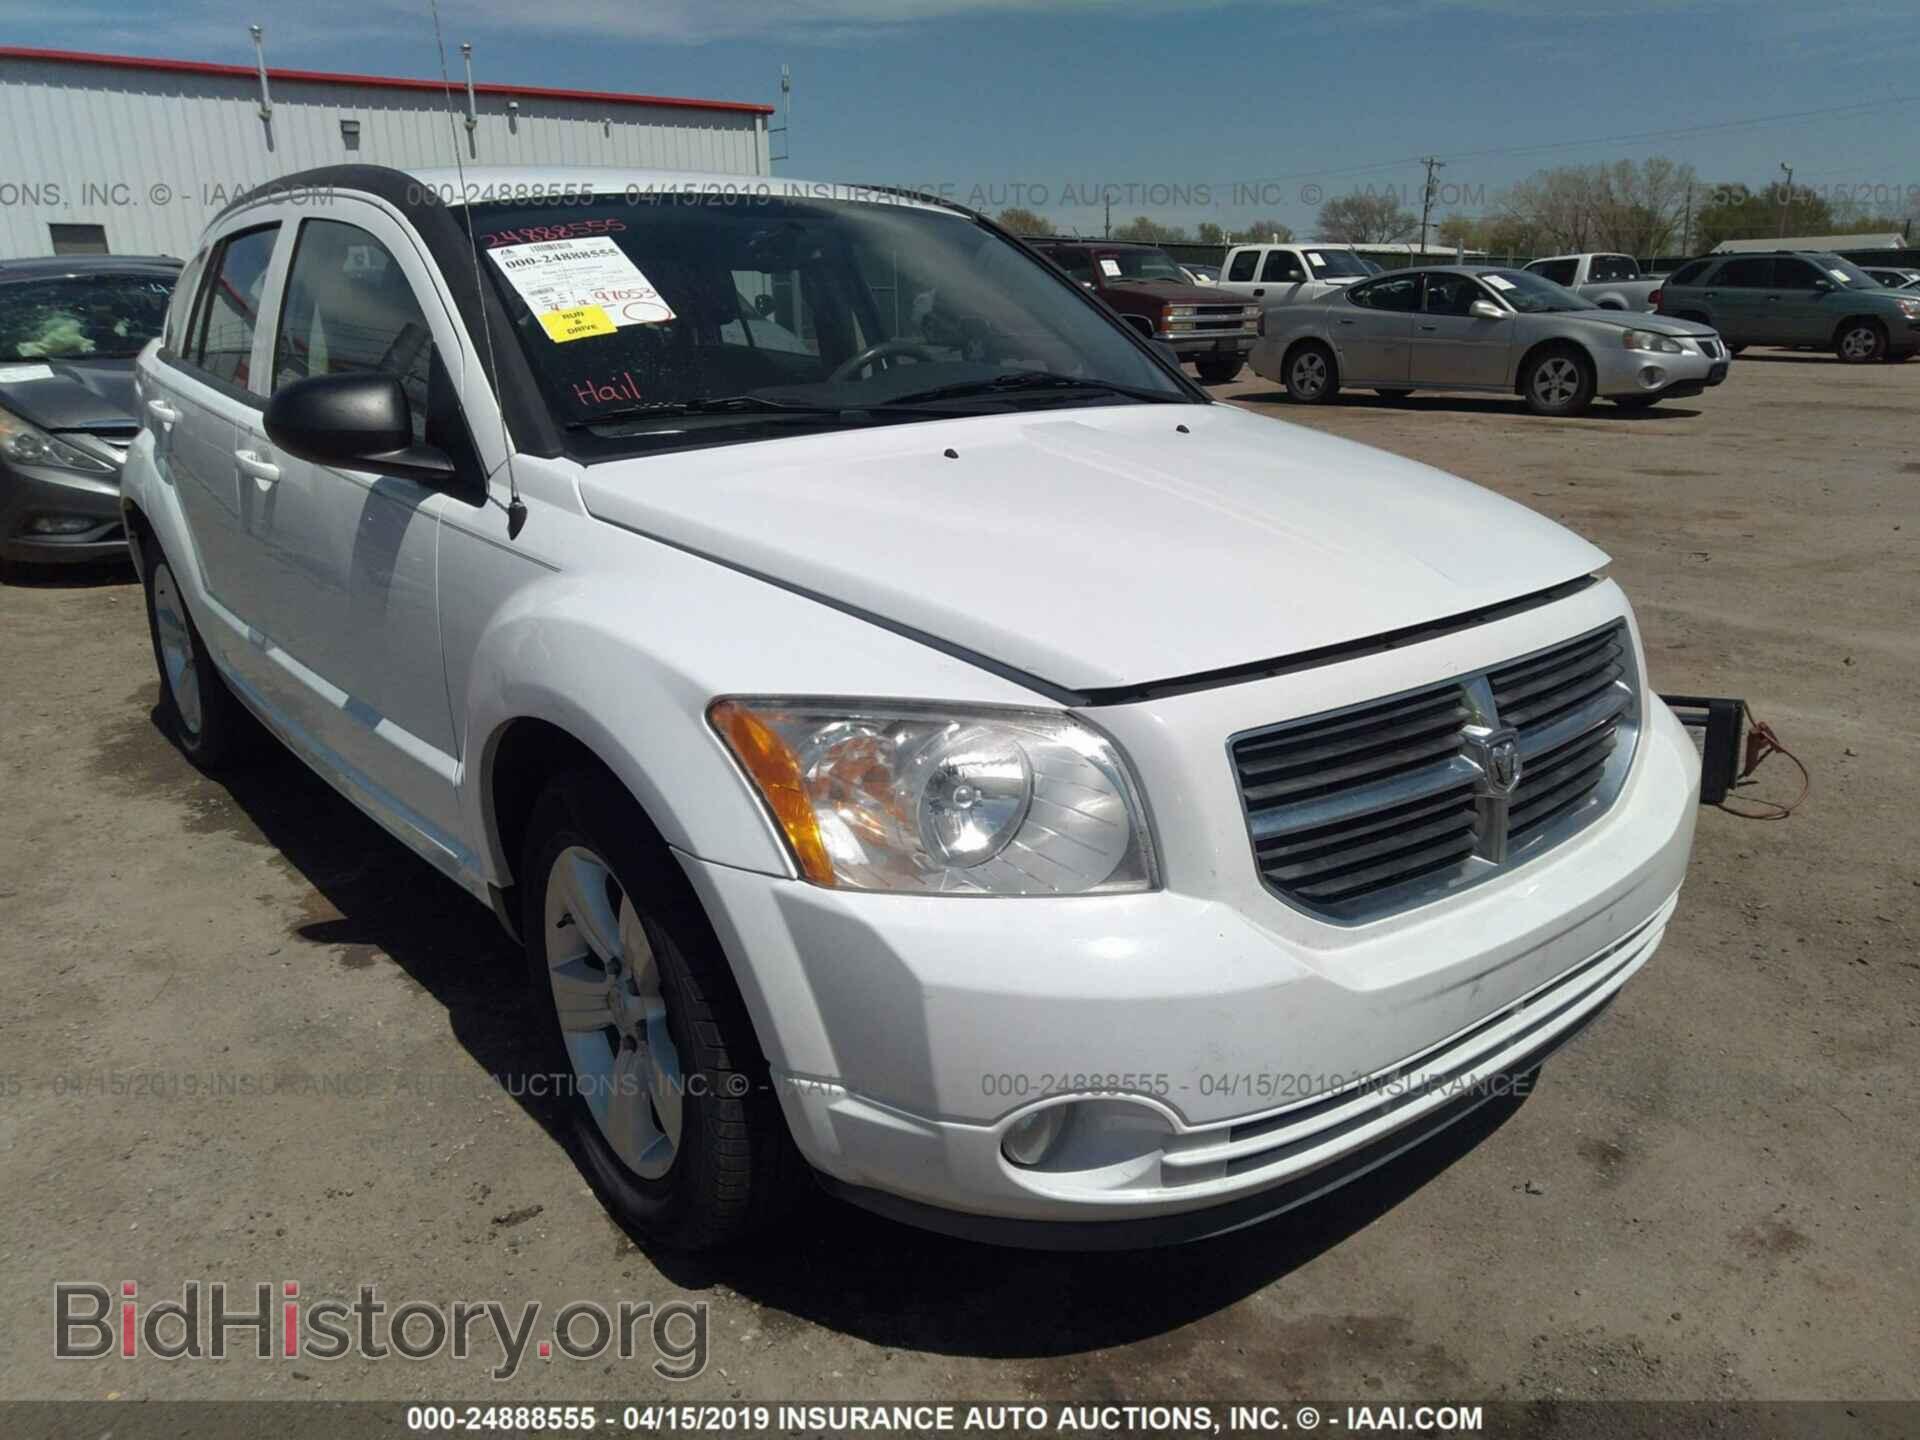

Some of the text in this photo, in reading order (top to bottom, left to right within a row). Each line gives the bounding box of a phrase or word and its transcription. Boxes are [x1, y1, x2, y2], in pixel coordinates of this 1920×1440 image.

[480, 219, 627, 247] 24888555
[504, 248, 620, 270] 000-24888555
[561, 311, 585, 320] RUN
[566, 324, 599, 335] DRIVE
[572, 371, 641, 406] Hail
